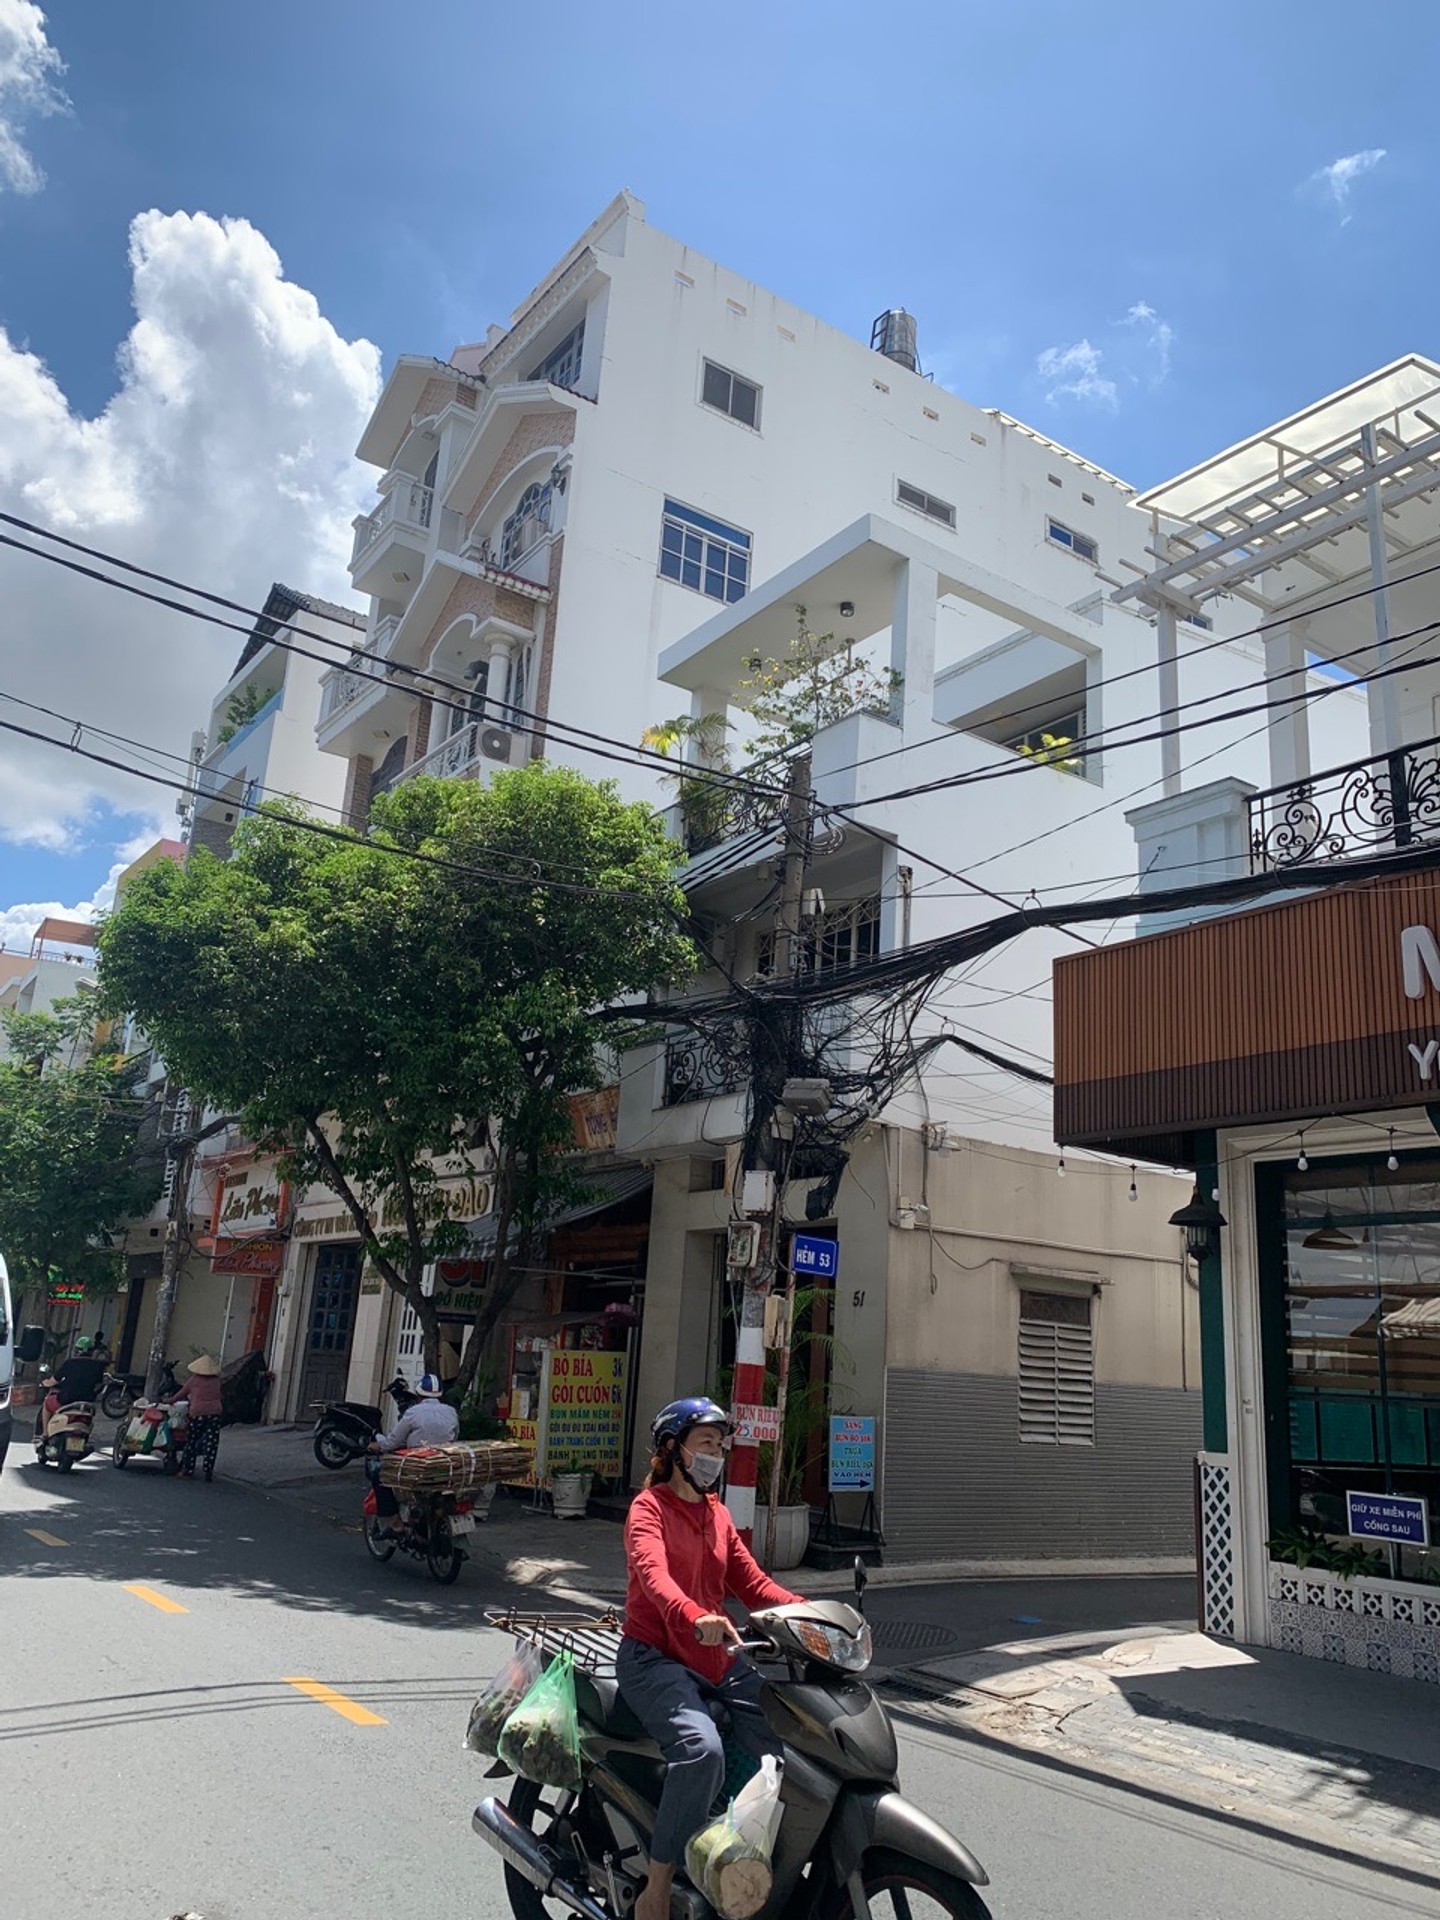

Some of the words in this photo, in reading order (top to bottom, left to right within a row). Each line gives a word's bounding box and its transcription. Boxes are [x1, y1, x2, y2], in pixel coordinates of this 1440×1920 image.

[1407, 1039, 1440, 1080] Y
[797, 1245, 815, 1265] HẺM
[819, 1253, 830, 1267] 53
[852, 1290, 865, 1307] 51
[576, 1377, 610, 1403] CUỐN
[735, 1424, 777, 1440] 25.000
[1369, 1506, 1381, 1515] XE
[1391, 1525, 1410, 1535] SAU
